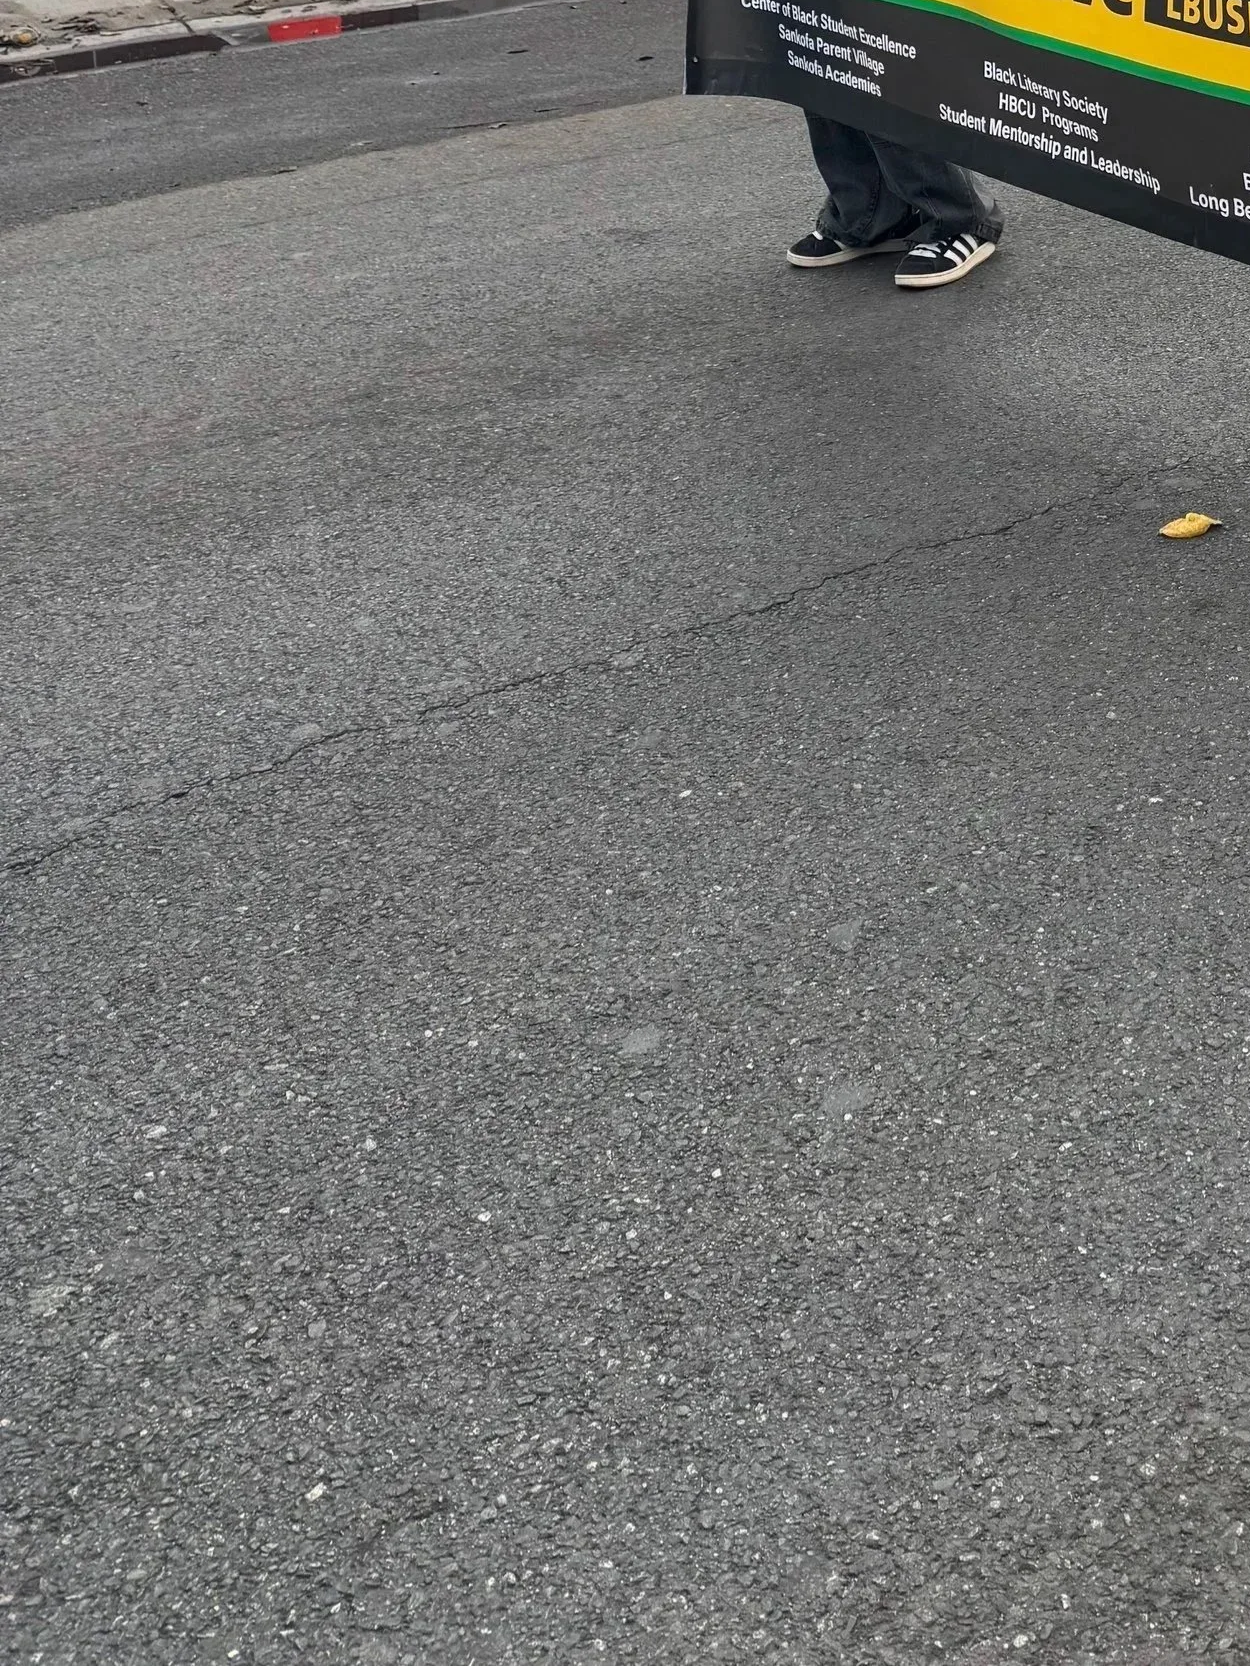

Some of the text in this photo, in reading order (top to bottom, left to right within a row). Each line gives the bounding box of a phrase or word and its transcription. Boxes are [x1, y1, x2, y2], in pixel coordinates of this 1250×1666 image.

[778, 23, 885, 77] Sankofa Parent Village
[781, 2, 791, 19] of
[791, 4, 819, 28] Black
[820, 13, 858, 41] Student
[858, 26, 917, 60] Excellence
[787, 49, 882, 98] Sankofa Academies
[983, 60, 1109, 125] Black Literary Society
[998, 91, 1100, 143] HBCU Programs
[938, 103, 1161, 195] Student Mentorship and Leadership
[1189, 185, 1230, 218] Long
